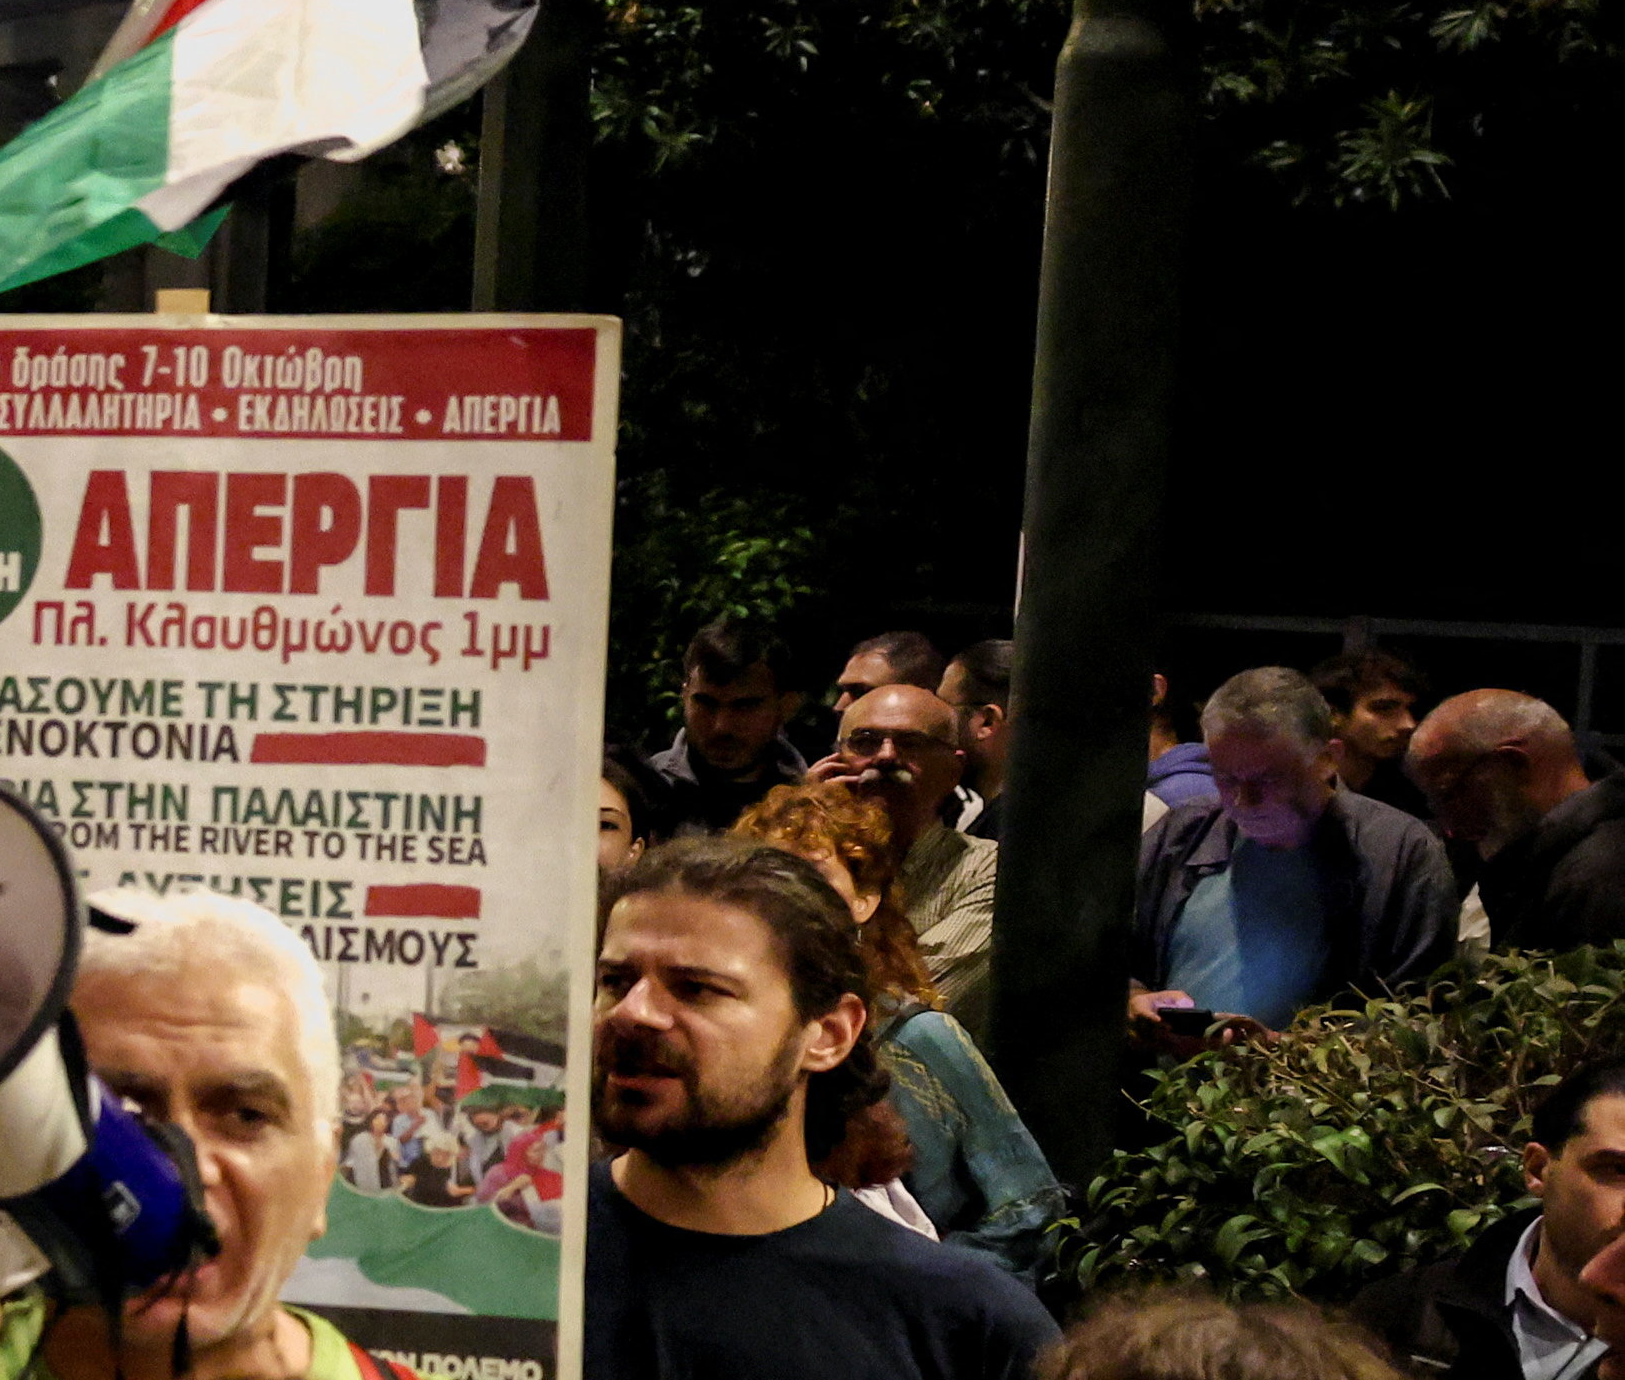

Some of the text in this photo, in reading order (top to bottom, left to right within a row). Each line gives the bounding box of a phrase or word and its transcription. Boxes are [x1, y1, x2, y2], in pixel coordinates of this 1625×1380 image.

[10, 344, 126, 392] δράσης
[140, 345, 210, 388] 7-10
[222, 345, 364, 394] Οκτώβρη
[238, 394, 405, 435] ΕΚΔΗΛΩΣΕΙΣ
[442, 395, 562, 435] ΑΠΕΡΓΙΑ
[63, 469, 550, 601] ΑΠΕΡΓΙΑ
[32, 601, 551, 671] Πλ. Κλαυθμώνος 1μμ
[197, 681, 259, 721] ΤΗ
[271, 682, 482, 728] ΣΤΗΡΙΞΗ
[71, 780, 189, 821] ΣΤΗΝ
[212, 785, 482, 833] ΠΑΛΑΙΣΤΙΝΗ
[129, 823, 191, 854] THE
[200, 826, 294, 859] RIVER
[303, 830, 346, 860] TO
[356, 832, 418, 863] THE
[427, 835, 487, 867] SEA
[301, 924, 480, 969] ΛΙΣΜΟΥΣ
